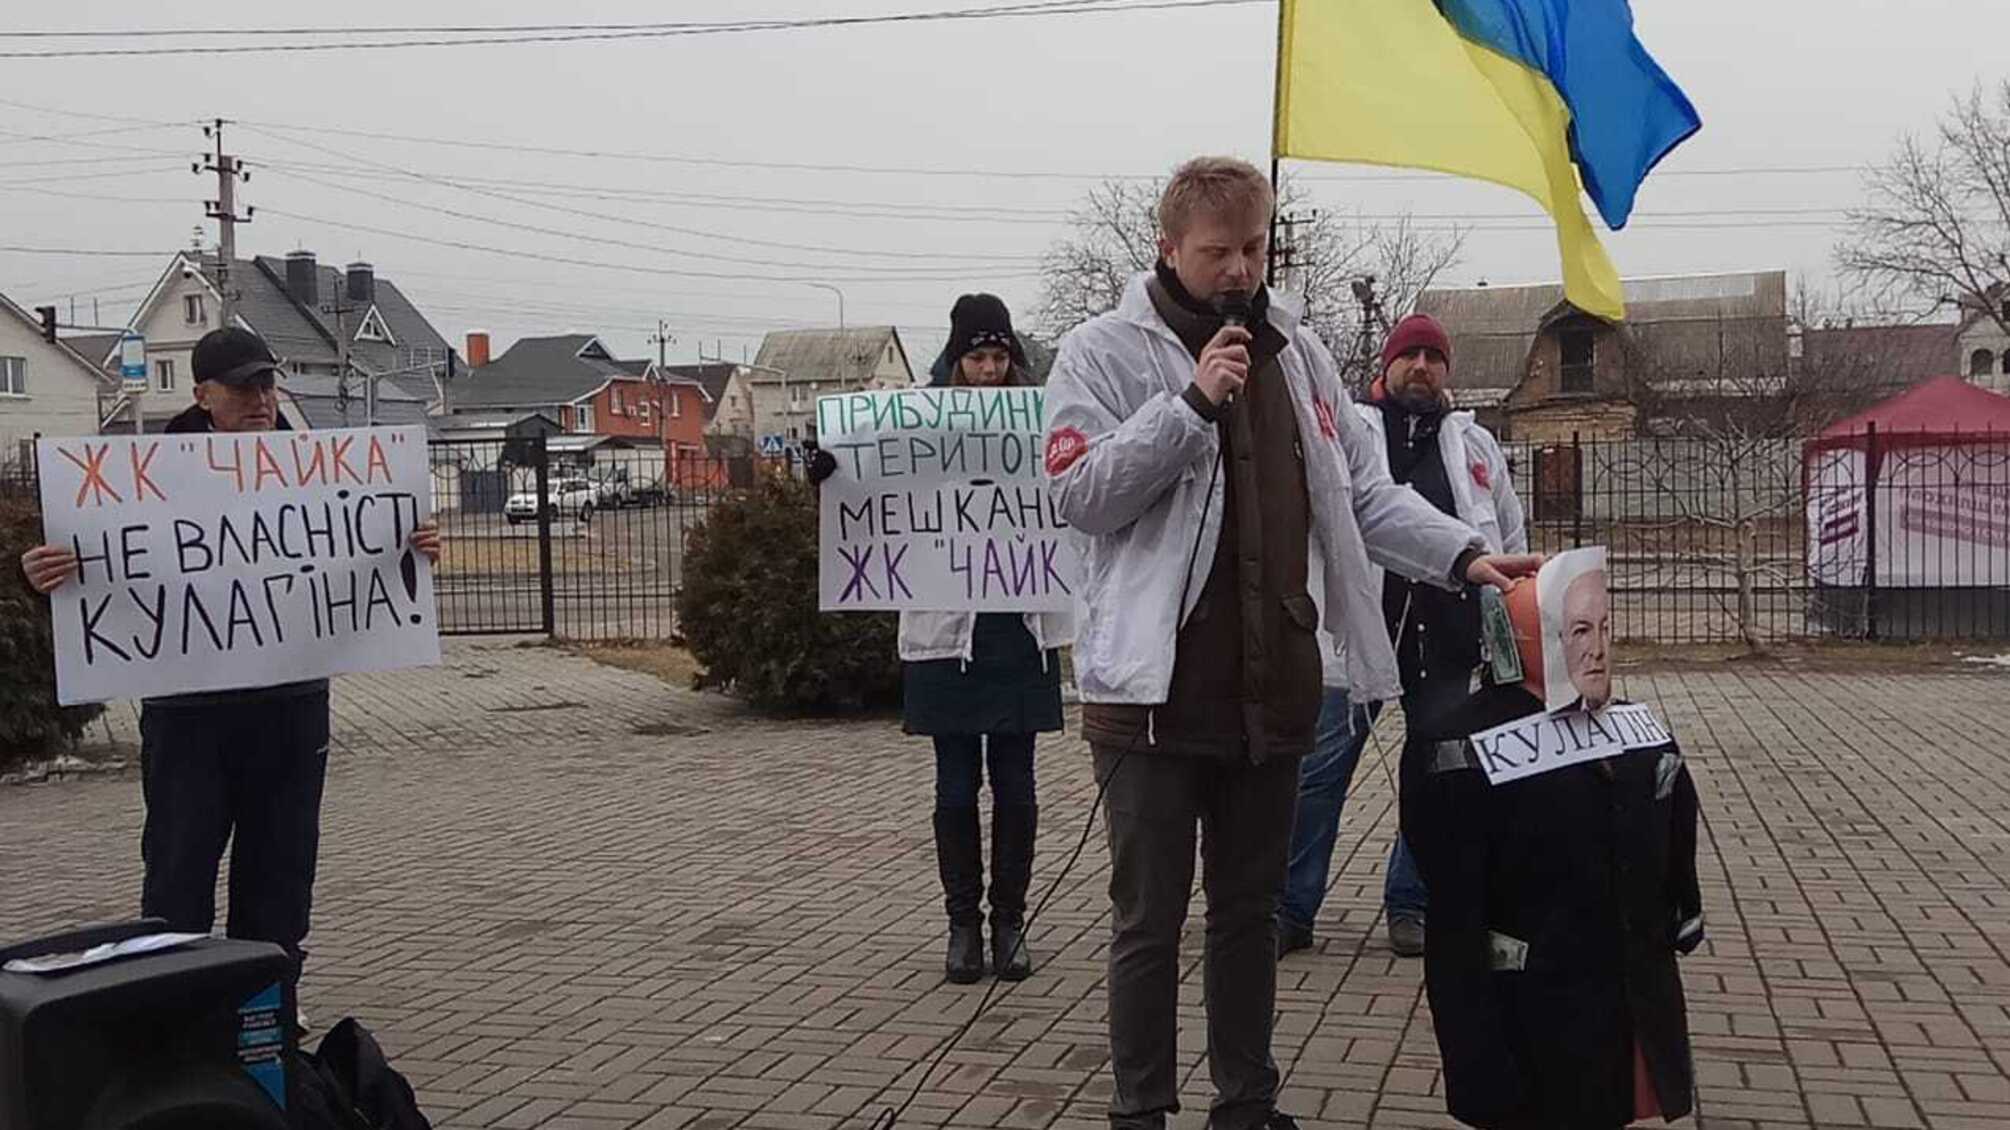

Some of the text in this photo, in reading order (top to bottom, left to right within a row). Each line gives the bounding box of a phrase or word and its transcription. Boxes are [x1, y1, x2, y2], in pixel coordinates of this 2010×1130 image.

[57, 432, 405, 508] ЖК "ЧАЙКА"
[73, 524, 150, 584] НЕ
[838, 541, 913, 603] ЖК
[80, 547, 422, 666] КУЛАГІНА!
